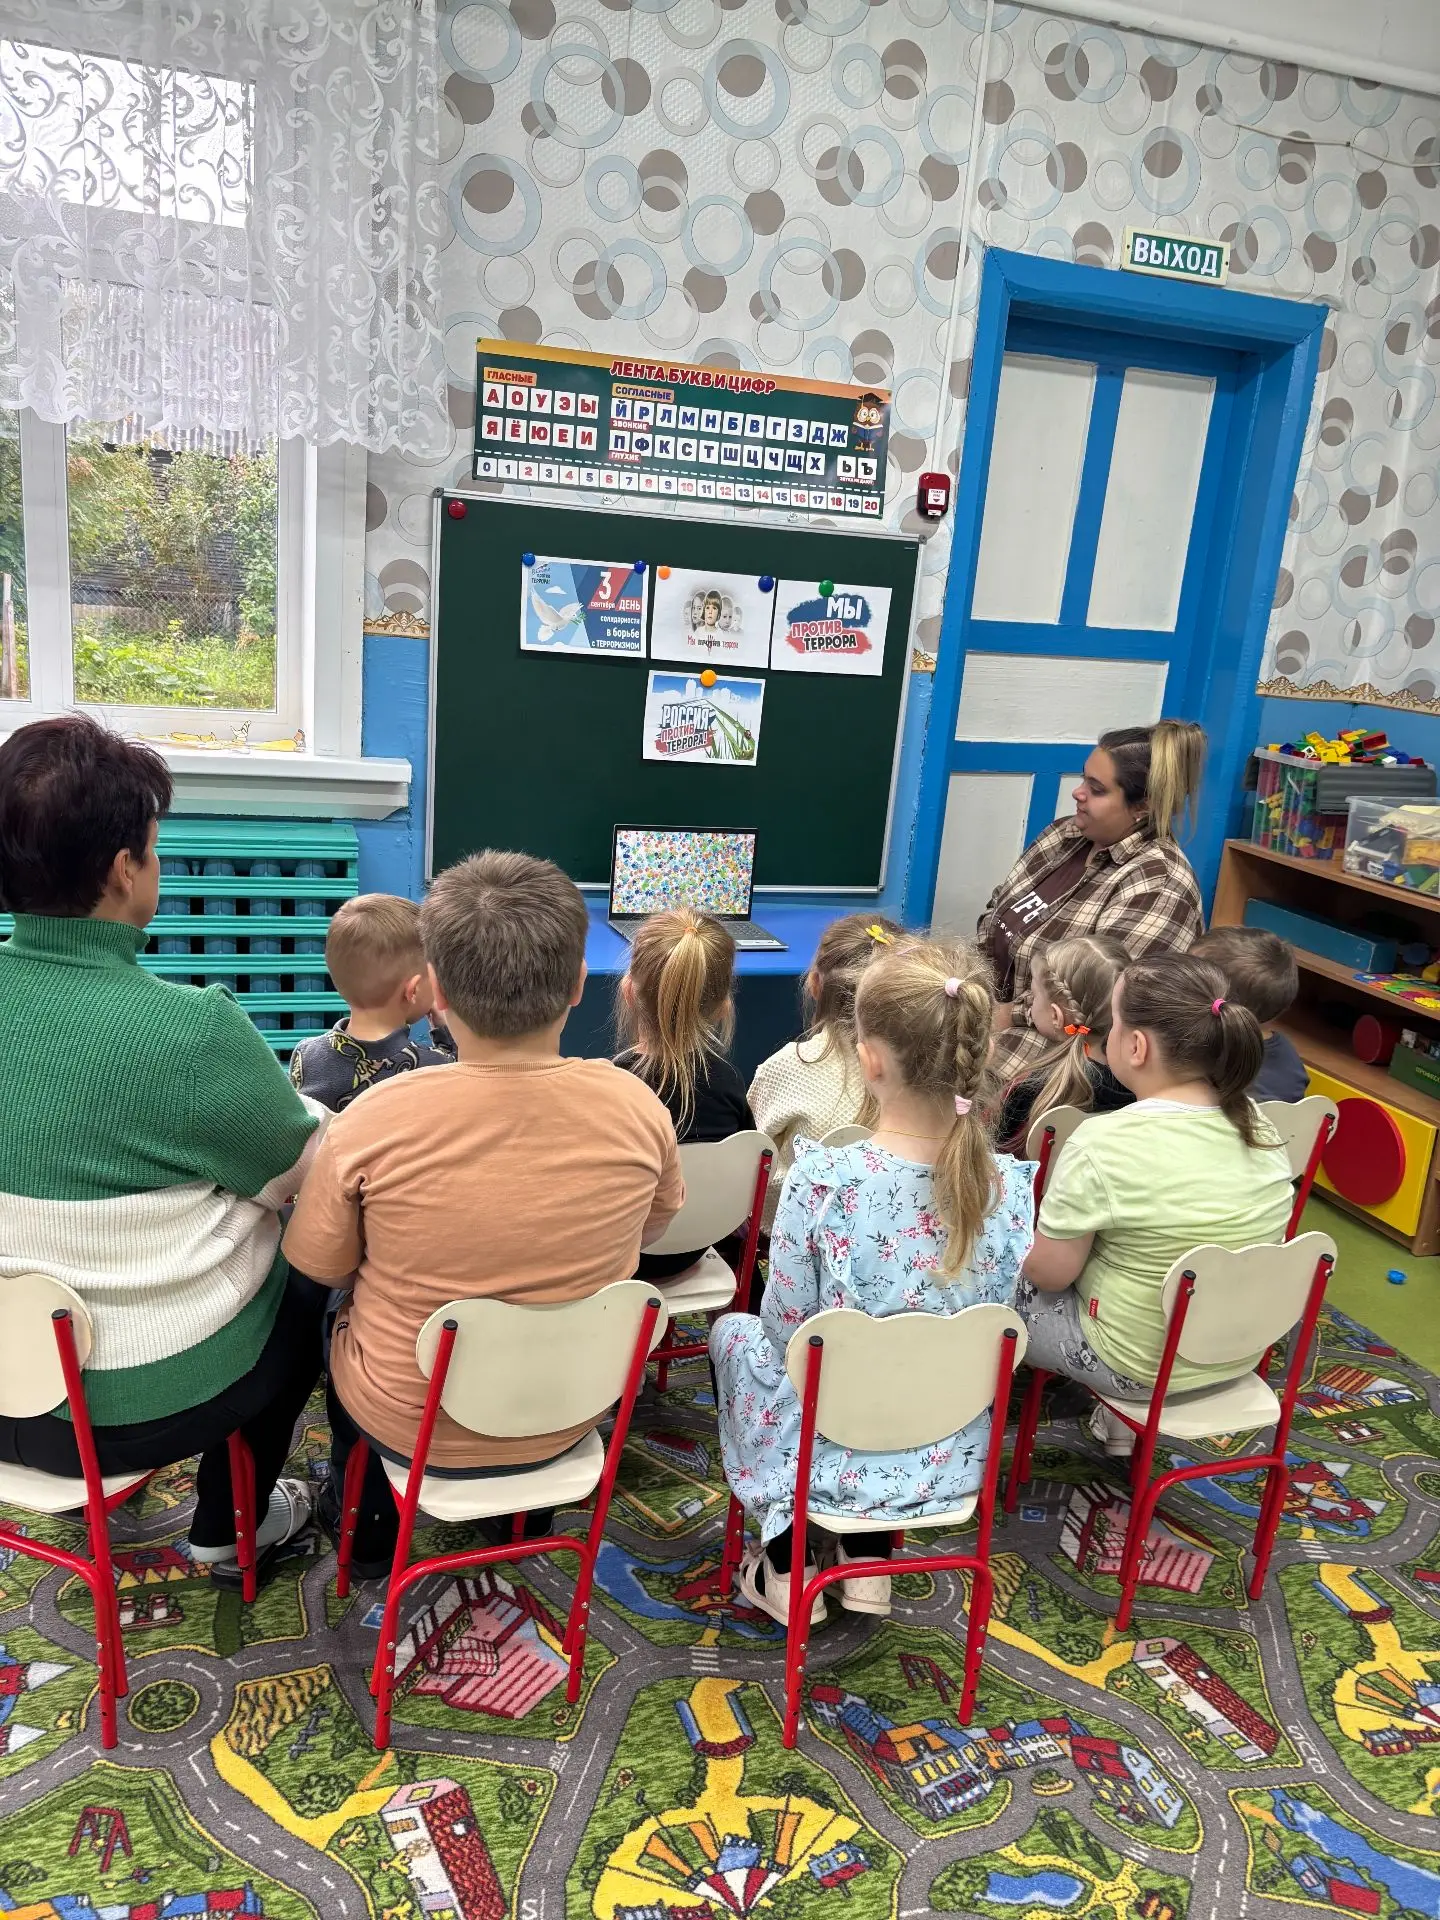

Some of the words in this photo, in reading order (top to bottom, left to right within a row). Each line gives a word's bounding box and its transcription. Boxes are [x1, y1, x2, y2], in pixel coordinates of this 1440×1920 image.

[1134, 237, 1218, 276] ВЫХОД
[487, 370, 533, 383] ГЛАСНЫЕ
[610, 361, 665, 381] ЛЕНТА
[668, 367, 712, 387] БУКВ
[714, 373, 726, 389] И
[727, 375, 776, 394] ЦИФР
[615, 386, 672, 400] СОГЛАСНЫЕ
[612, 420, 647, 430] ЗВОНКИЕ
[611, 452, 640, 461] ГЛУХИЕ
[483, 462, 491, 472] 0
[505, 465, 510, 474] 1
[525, 467, 532, 476] 2
[546, 469, 552, 478] 3
[565, 471, 573, 480] 4
[586, 473, 593, 482] 5
[606, 475, 613, 483] 6
[626, 477, 632, 485] 7
[645, 479, 652, 487] 8
[665, 481, 672, 489] 9
[681, 483, 693, 492] 10
[702, 485, 711, 494] 11
[720, 487, 731, 496] 12
[738, 489, 750, 497] 13
[757, 491, 769, 499] 14
[776, 492, 787, 501] 15
[794, 494, 806, 503] 16
[813, 496, 824, 504] 17
[831, 497, 842, 506] 18
[848, 499, 859, 508] 19
[865, 501, 877, 510] 20
[599, 571, 611, 600] 3
[590, 601, 616, 610] сентября
[619, 599, 641, 611] ДЕНЬ
[826, 596, 863, 619] МЫ
[600, 615, 640, 625] солидарности
[792, 620, 842, 637] ПРОТИВ
[612, 627, 640, 640] борьбе
[597, 640, 640, 651] ТЕРРОРИЗМОМ
[803, 634, 857, 651] ТЕРРОРА
[662, 705, 710, 730] РОССИЯ
[661, 724, 695, 742] ПРОТИВ
[666, 732, 708, 752] ТЕРРОРА!
[1153, 1746, 1202, 1796] BUS
